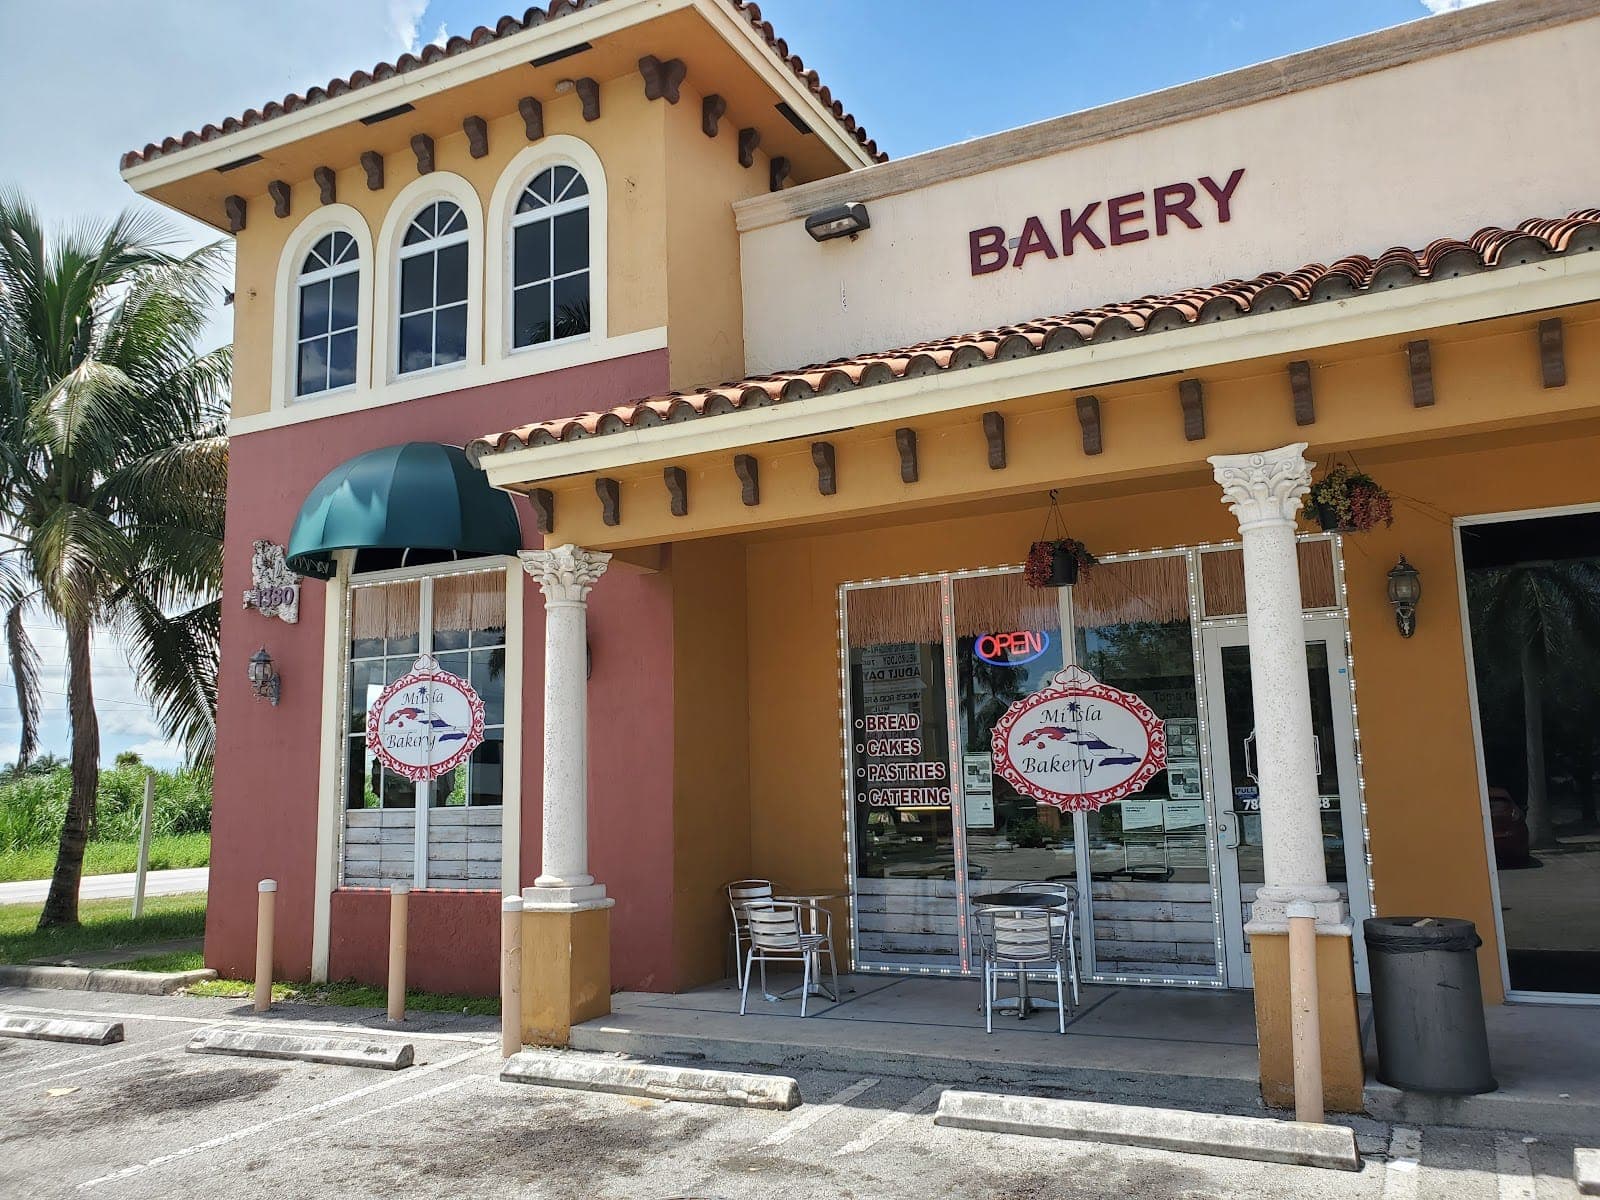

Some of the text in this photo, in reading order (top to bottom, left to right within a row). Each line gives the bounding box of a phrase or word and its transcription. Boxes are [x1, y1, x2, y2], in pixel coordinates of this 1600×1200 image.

[969, 168, 1246, 276] BAKERY
[255, 586, 295, 607] 1380
[978, 630, 1042, 659] OPEN
[401, 692, 419, 706] Mi
[866, 714, 920, 732] BREAD
[1039, 708, 1067, 724] Mi
[386, 732, 437, 753] Bakery
[867, 738, 921, 756] CAKES
[868, 762, 946, 781] PASTRIES
[1022, 753, 1095, 778] Bakery
[869, 787, 952, 806] CATERING
